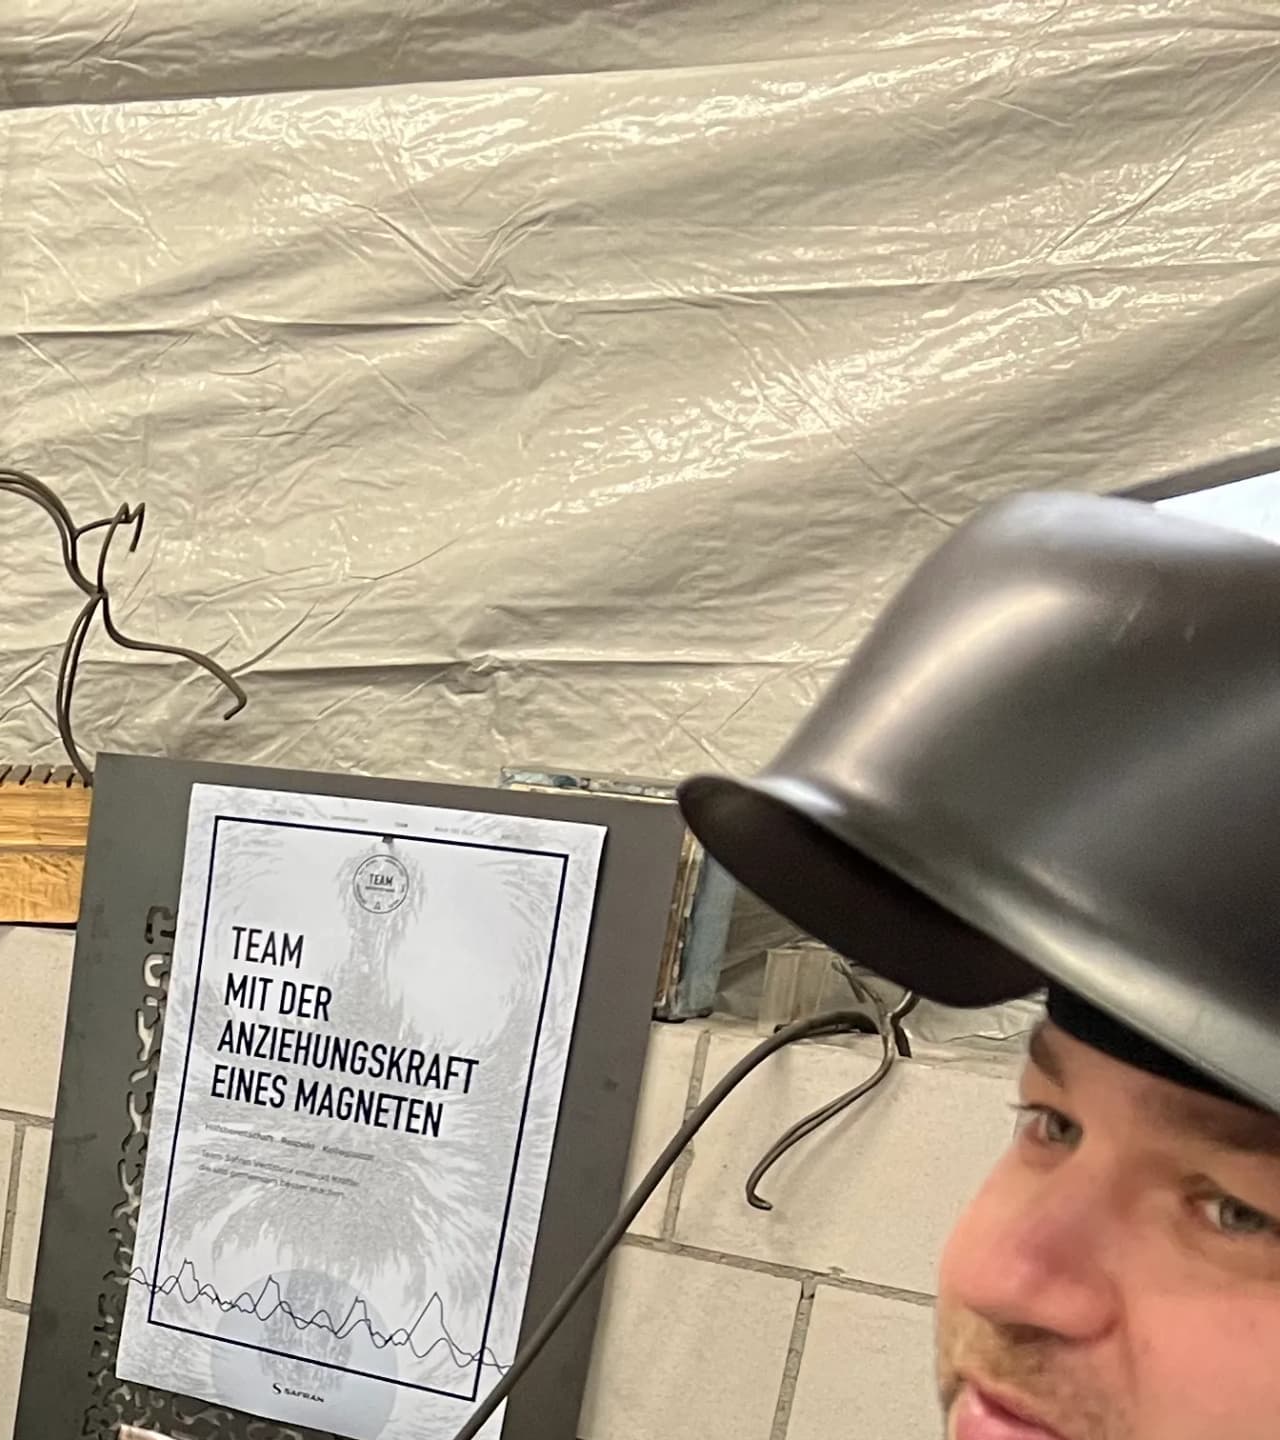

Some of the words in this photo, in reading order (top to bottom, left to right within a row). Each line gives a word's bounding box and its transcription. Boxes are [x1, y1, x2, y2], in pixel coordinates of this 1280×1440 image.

[369, 873, 394, 887] TEAM
[232, 926, 304, 969] TEAM
[224, 972, 274, 1012] MIT
[279, 980, 333, 1022] DER
[217, 1019, 480, 1094] ANZIEHUNGSKRAFT
[210, 1064, 288, 1109] EINES
[294, 1078, 444, 1138] MAGNETEN
